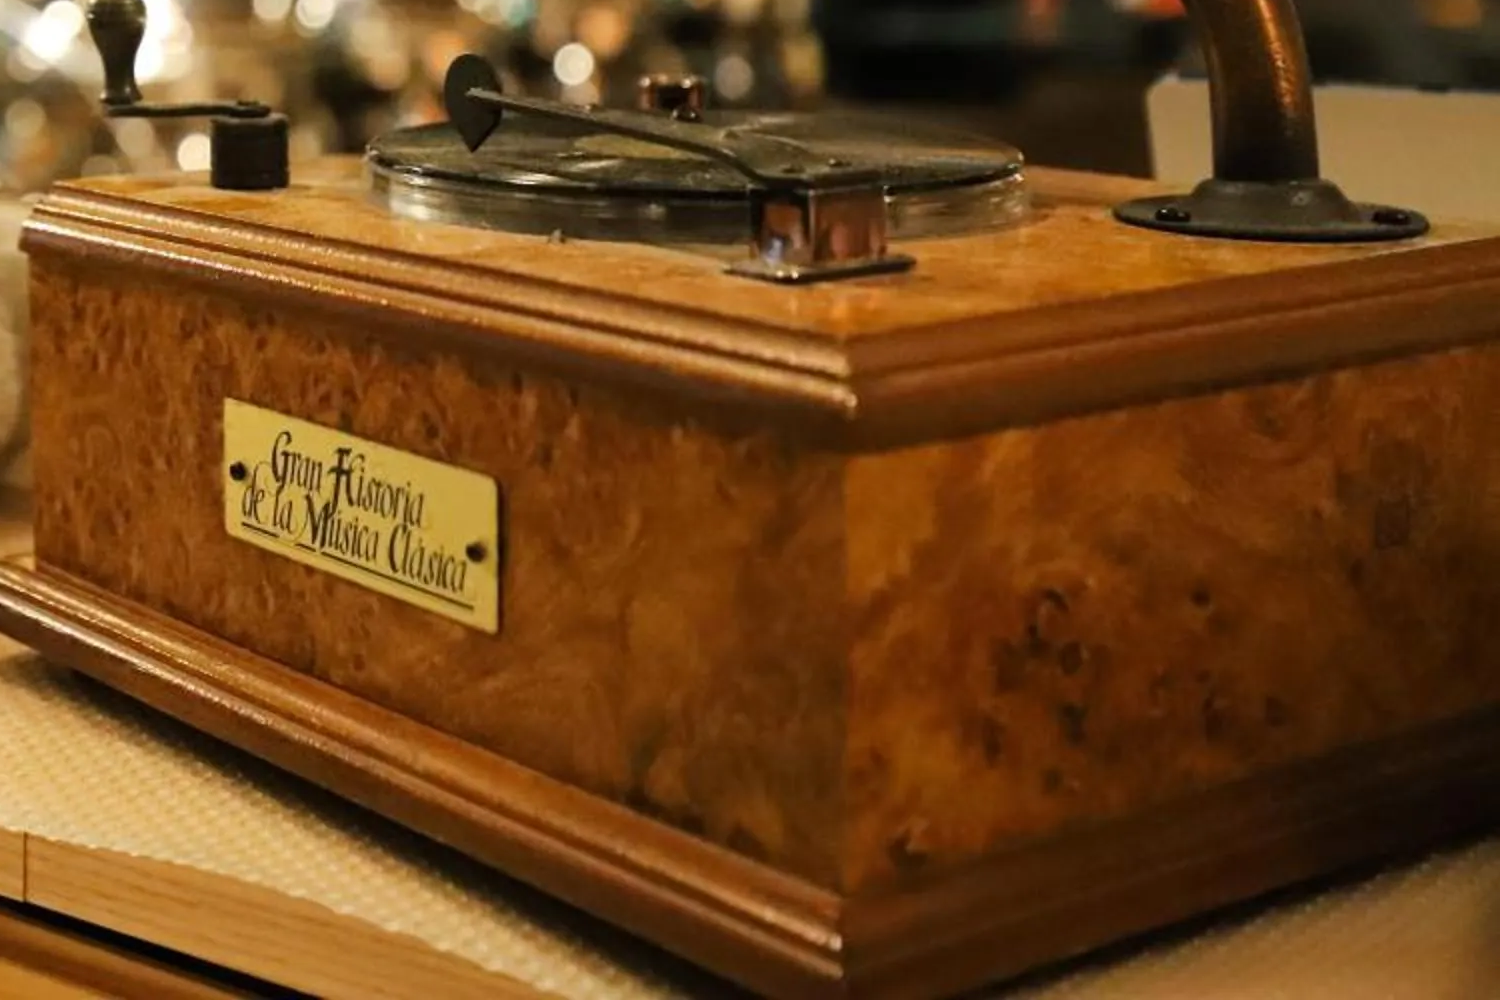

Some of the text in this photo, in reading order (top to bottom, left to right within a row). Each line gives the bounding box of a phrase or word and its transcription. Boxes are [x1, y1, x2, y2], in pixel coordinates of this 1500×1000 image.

[241, 463, 468, 593] de la Música Clásica
[271, 431, 424, 528] Gran Historia
